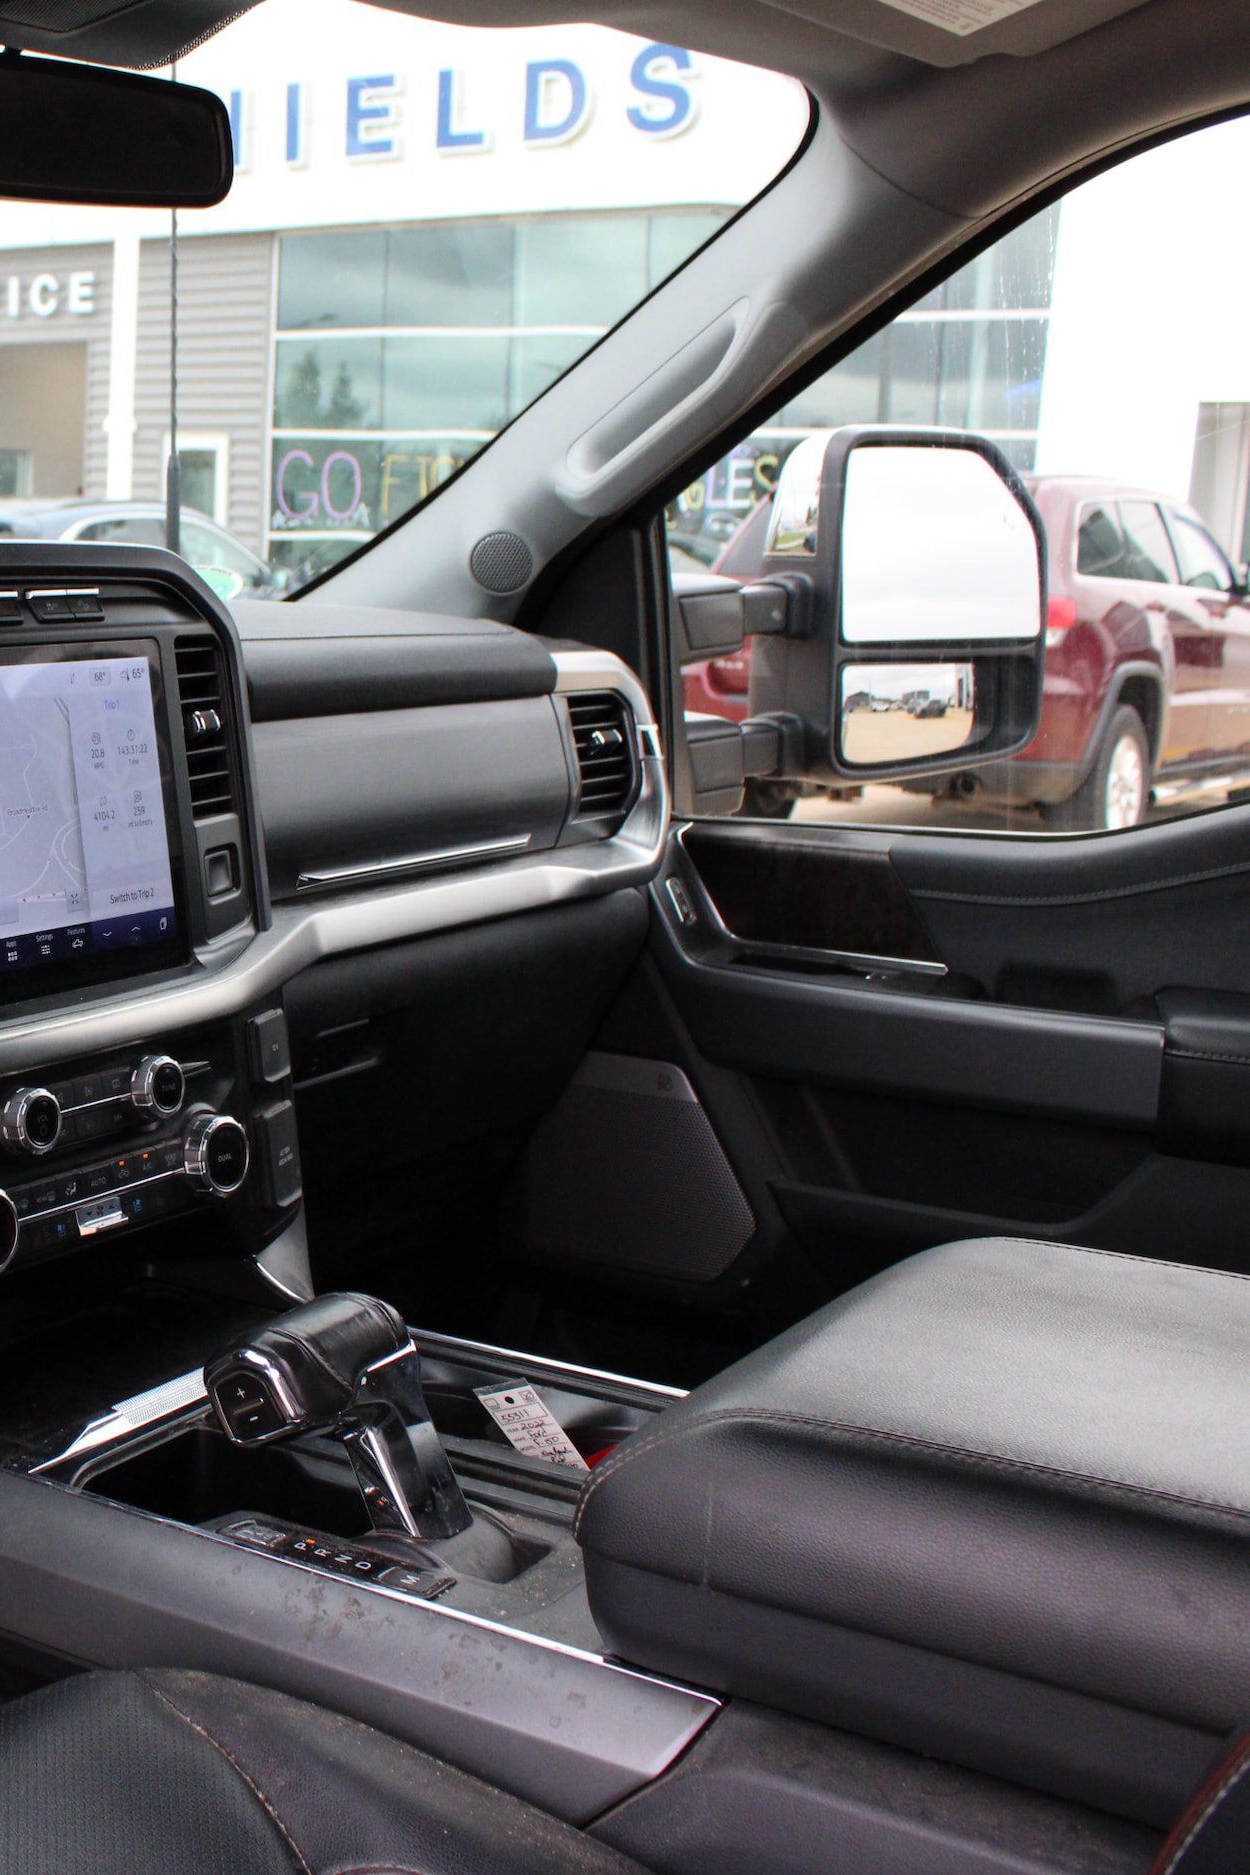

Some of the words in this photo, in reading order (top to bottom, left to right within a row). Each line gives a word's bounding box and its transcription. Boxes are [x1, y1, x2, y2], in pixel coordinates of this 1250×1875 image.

[276, 449, 364, 520] GO
[110, 892, 130, 904] Switch
[130, 892, 138, 900] to
[138, 890, 150, 900] Trip
[36, 934, 54, 942] Settings
[218, 1154, 232, 1162] DUAL
[90, 1176, 107, 1187] AUTO
[501, 1408, 530, 1422] 55311
[521, 1420, 546, 1431] 2022
[294, 1542, 306, 1550] P
[314, 1548, 331, 1558] R
[335, 1554, 352, 1564] N
[354, 1561, 372, 1570] D
[400, 1574, 420, 1586] M
